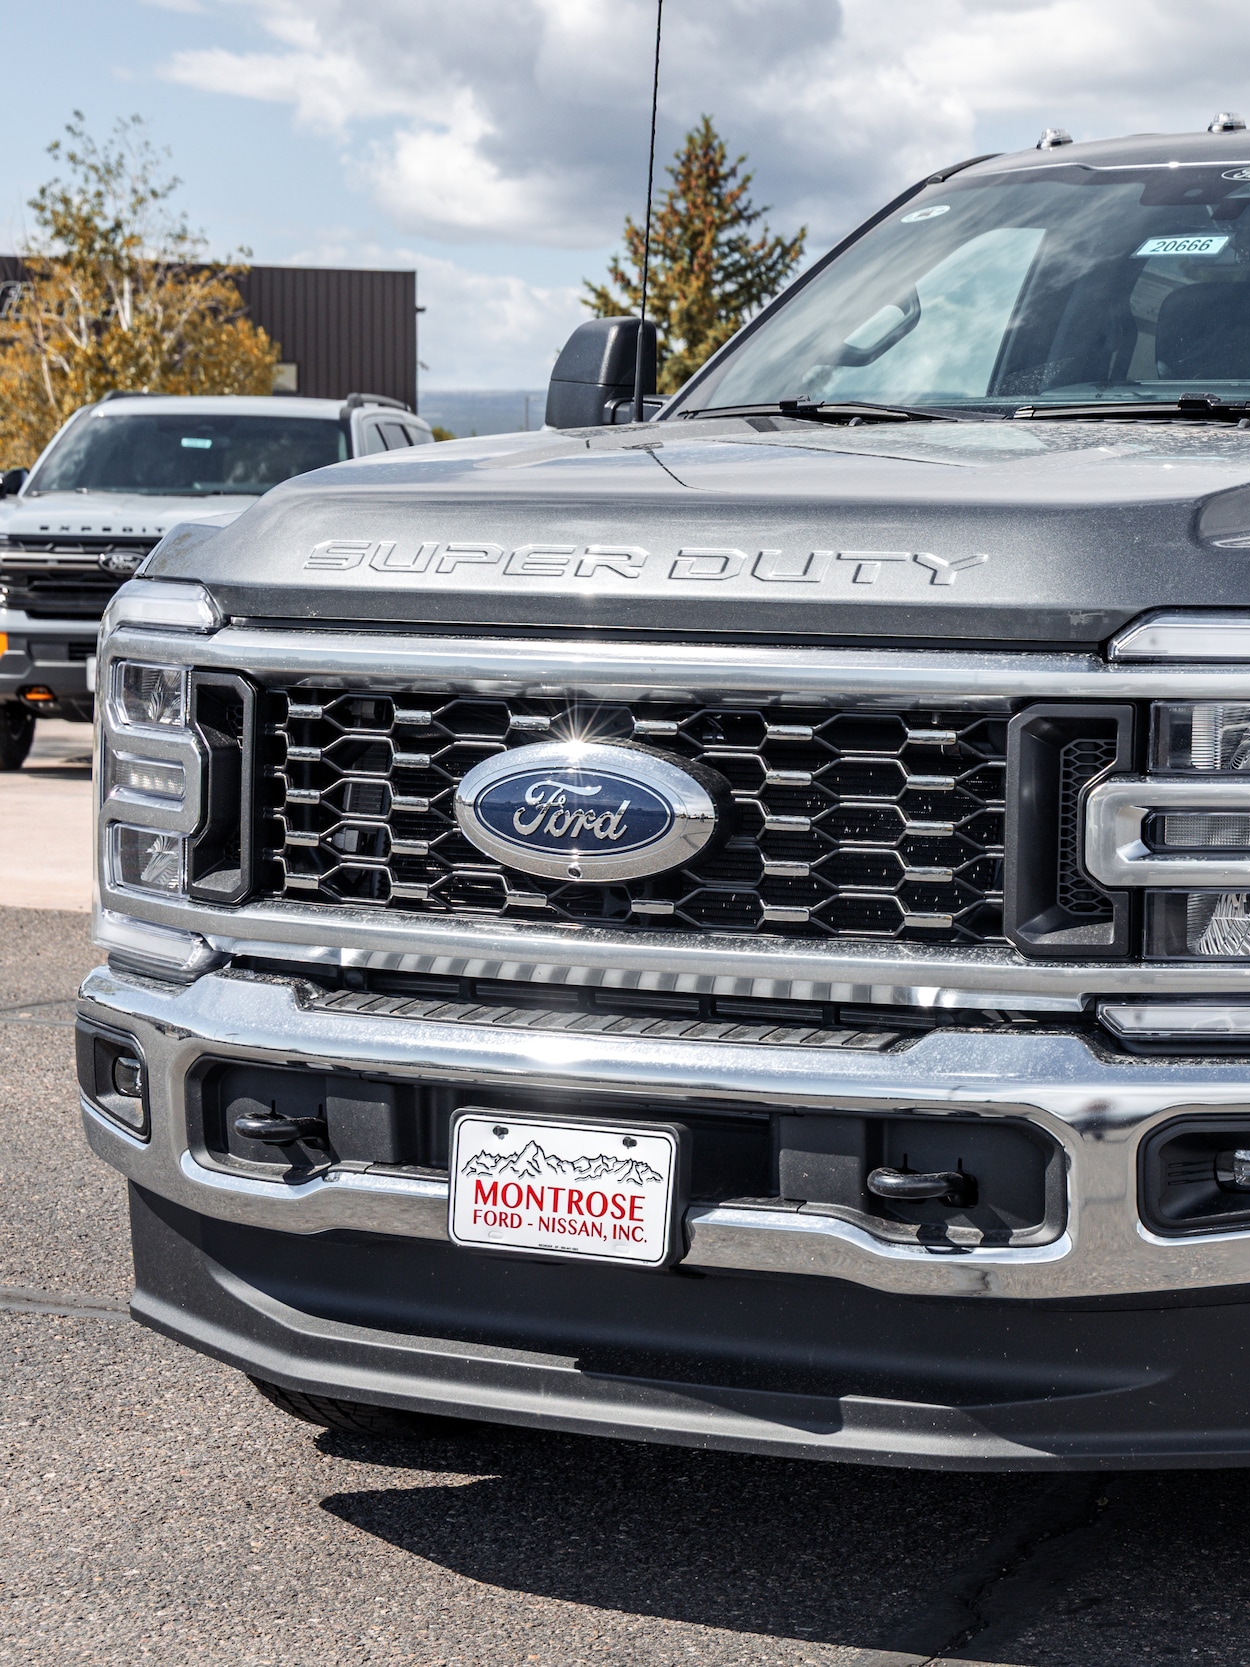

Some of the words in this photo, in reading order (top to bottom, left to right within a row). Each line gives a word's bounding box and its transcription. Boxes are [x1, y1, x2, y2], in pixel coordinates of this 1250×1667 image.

[1149, 239, 1213, 252] 20666
[303, 539, 647, 580] SUPER
[668, 546, 989, 586] DUTY
[513, 781, 632, 841] Ford
[474, 1179, 646, 1222] MONTROSE
[473, 1209, 523, 1229] FORD
[538, 1216, 608, 1242] NISSAN,
[612, 1224, 648, 1243] INC.
